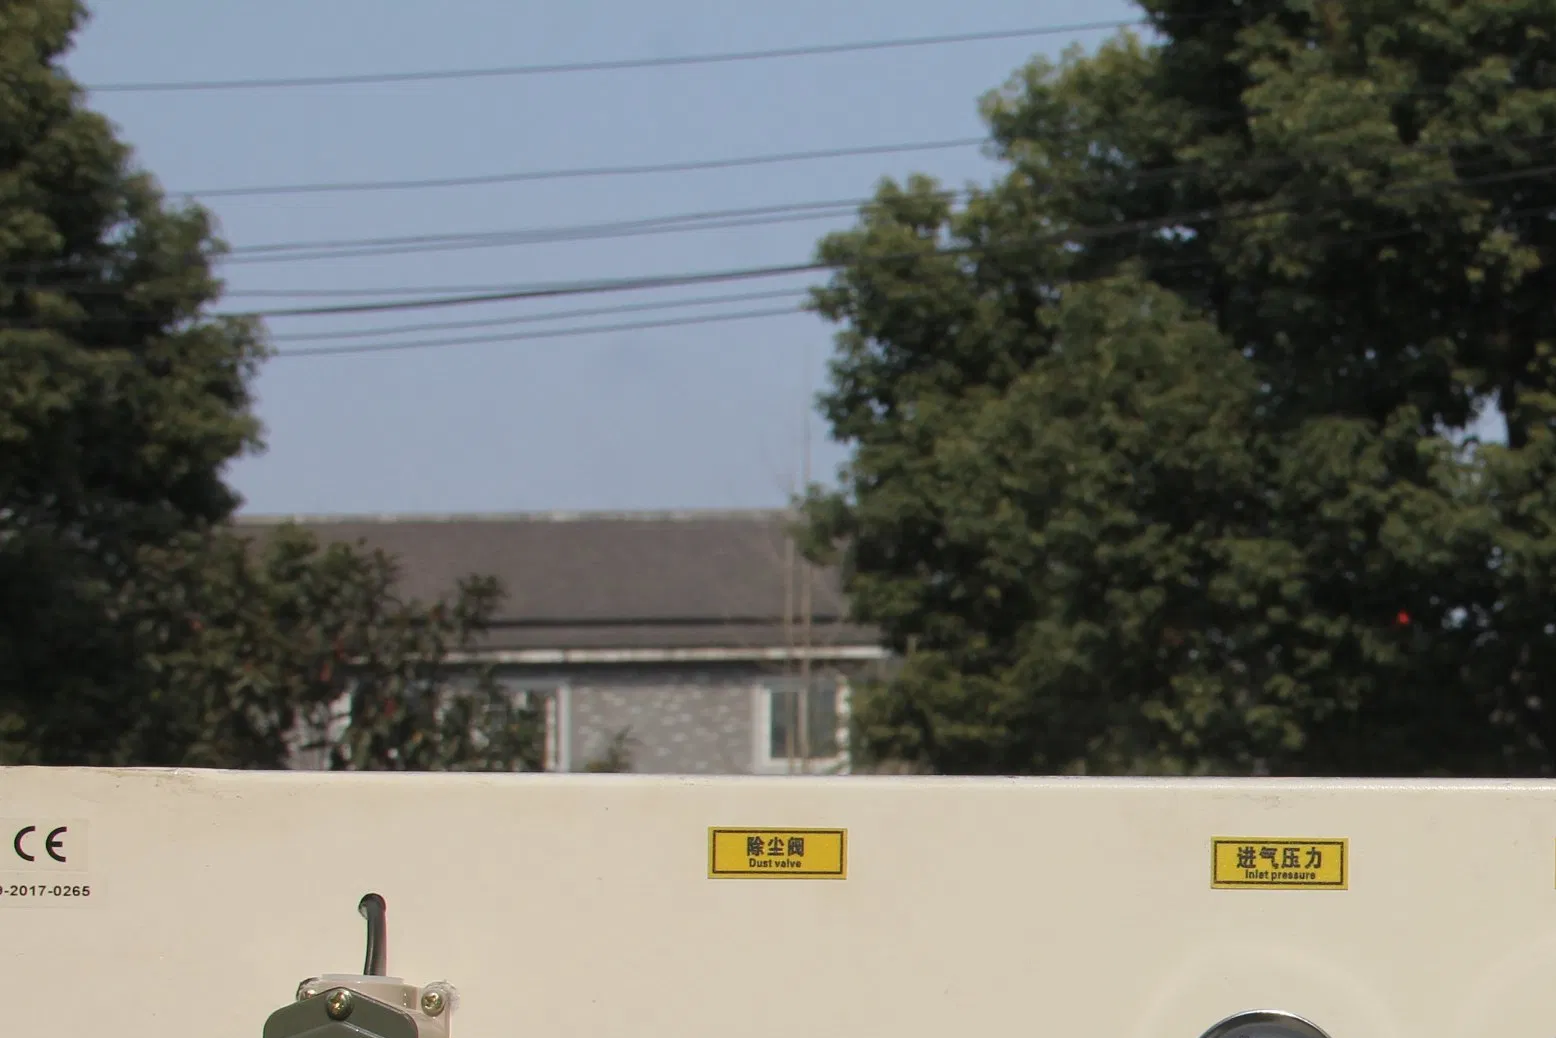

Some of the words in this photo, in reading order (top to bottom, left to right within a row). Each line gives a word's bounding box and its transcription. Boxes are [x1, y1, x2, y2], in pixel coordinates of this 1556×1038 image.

[13, 825, 68, 863] CE
[747, 836, 804, 856] 除尘阀
[749, 858, 772, 868] Dust
[775, 859, 801, 868] valve
[1237, 847, 1322, 869] 进气压力
[1245, 870, 1268, 879] Inlet
[1271, 871, 1316, 880] pressure
[0, 885, 91, 897] -2017-0265
